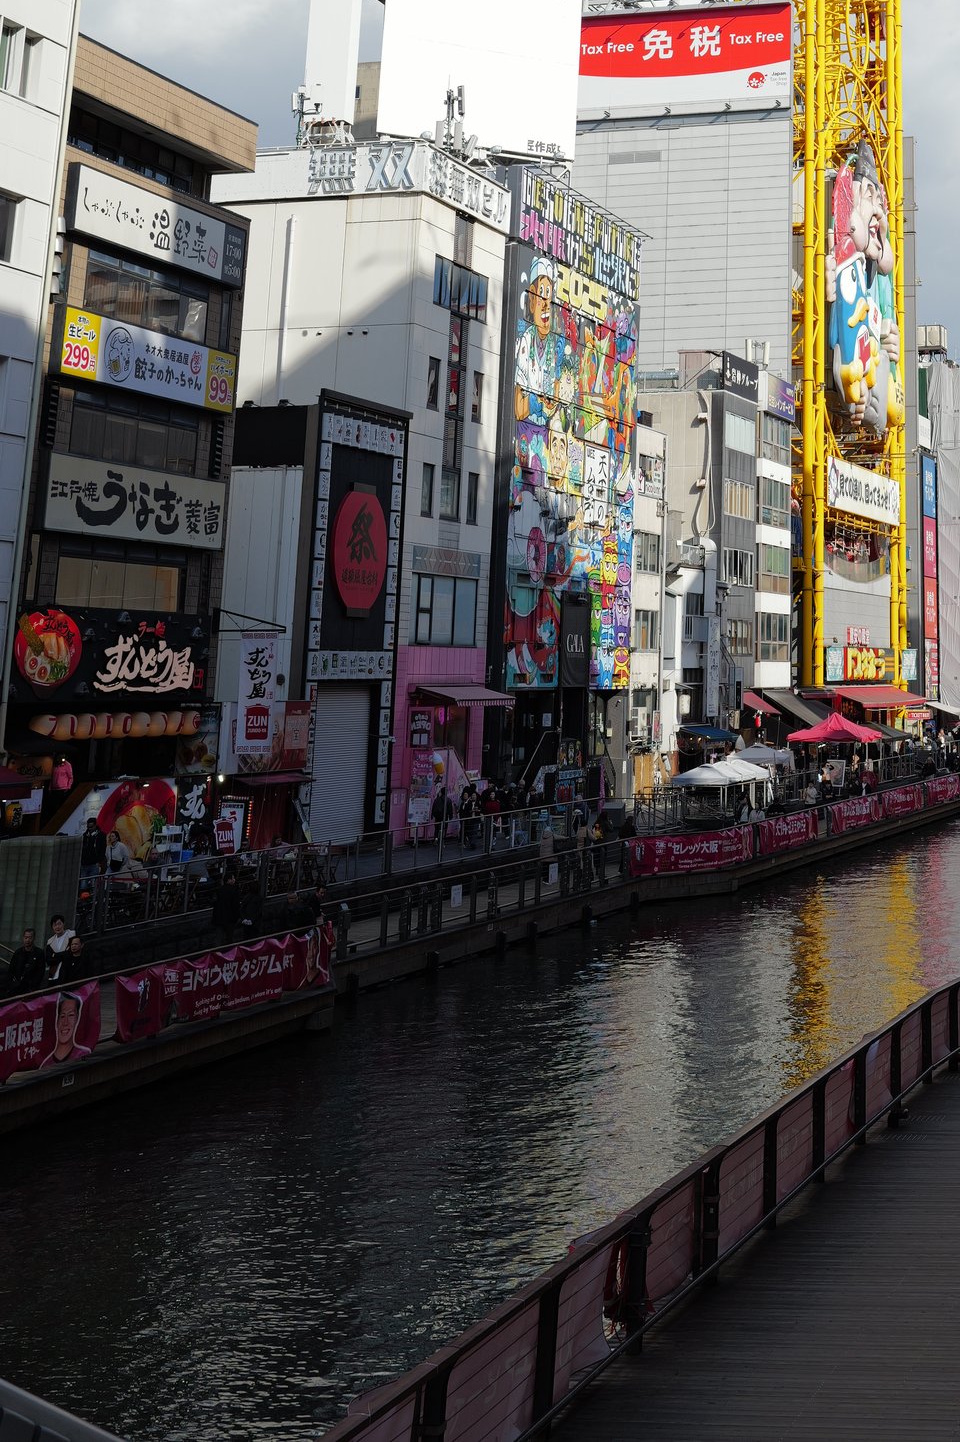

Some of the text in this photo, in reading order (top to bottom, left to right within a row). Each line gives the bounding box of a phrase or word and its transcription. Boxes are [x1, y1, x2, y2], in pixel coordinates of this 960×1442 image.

[581, 42, 635, 55] Tax Free
[642, 25, 721, 61] 免税
[729, 31, 785, 45] Tax Free
[83, 187, 207, 264] しゃぶしゃぶ 温野菜
[225, 244, 242, 259] 17:00
[556, 263, 609, 322] 2025
[68, 324, 96, 341] 生ビール
[145, 343, 189, 366] ネオ大衆居酒屋
[134, 357, 202, 391] 餃子のかっちゃん
[75, 470, 183, 535] うなぎ
[566, 633, 585, 654] GALA
[92, 634, 195, 693] ずんどう屋
[244, 647, 271, 700] ずんどう屋
[247, 715, 268, 727] ZUN
[218, 829, 233, 842] ZUN
